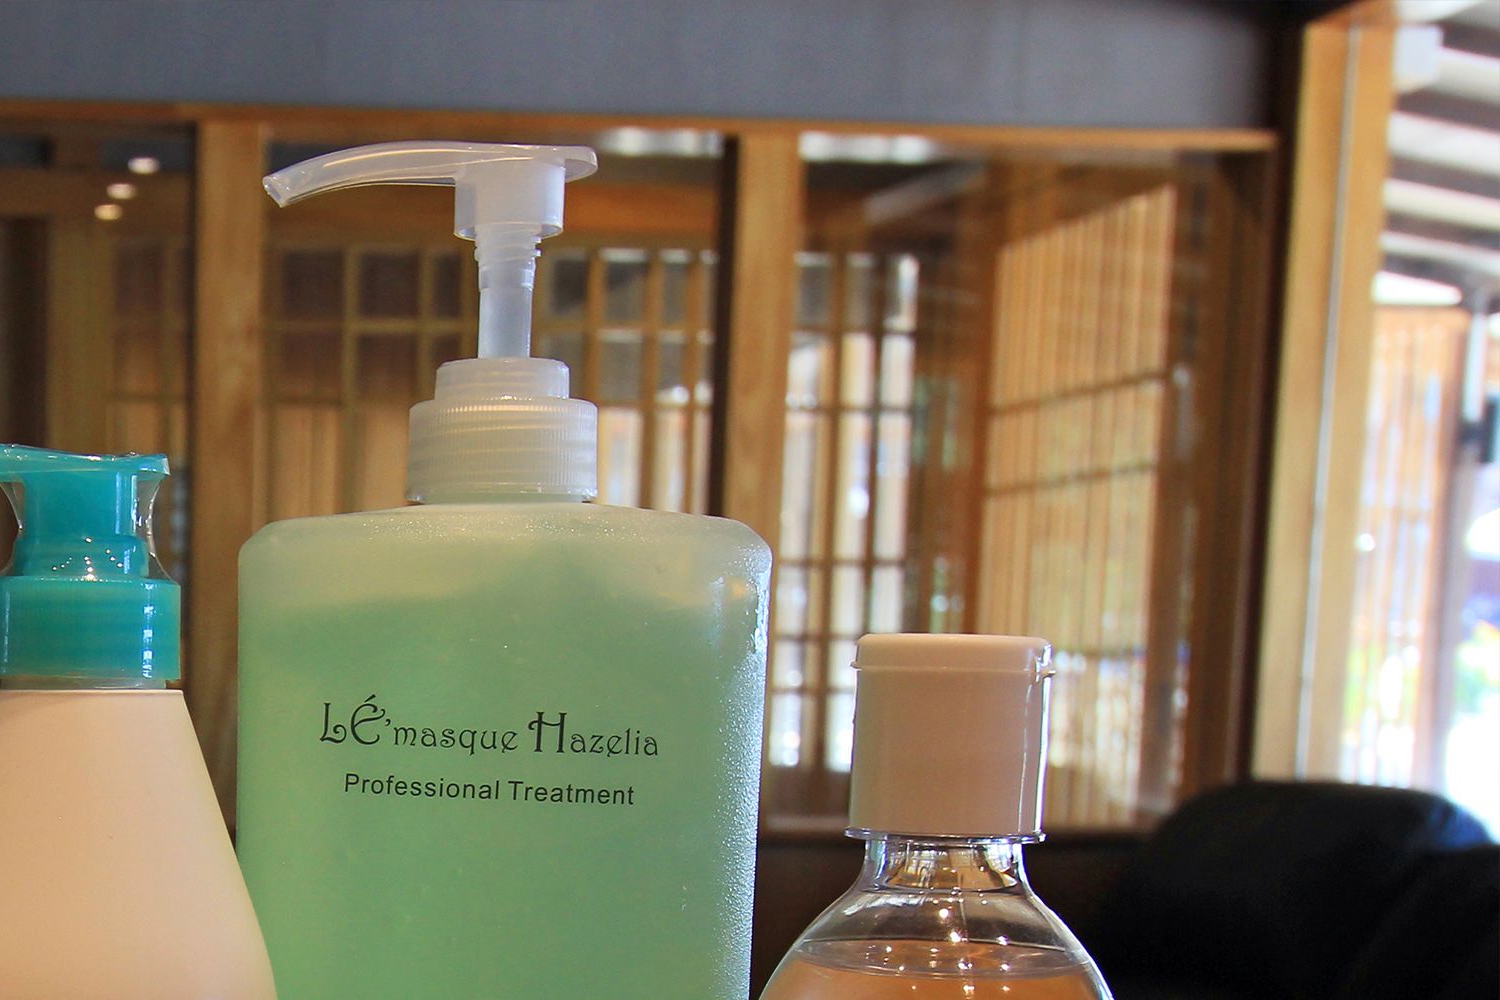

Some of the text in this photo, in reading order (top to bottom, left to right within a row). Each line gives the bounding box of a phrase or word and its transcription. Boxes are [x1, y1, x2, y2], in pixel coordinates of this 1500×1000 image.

[527, 711, 659, 758] Hazelia
[344, 772, 634, 805] Professional Treatment
